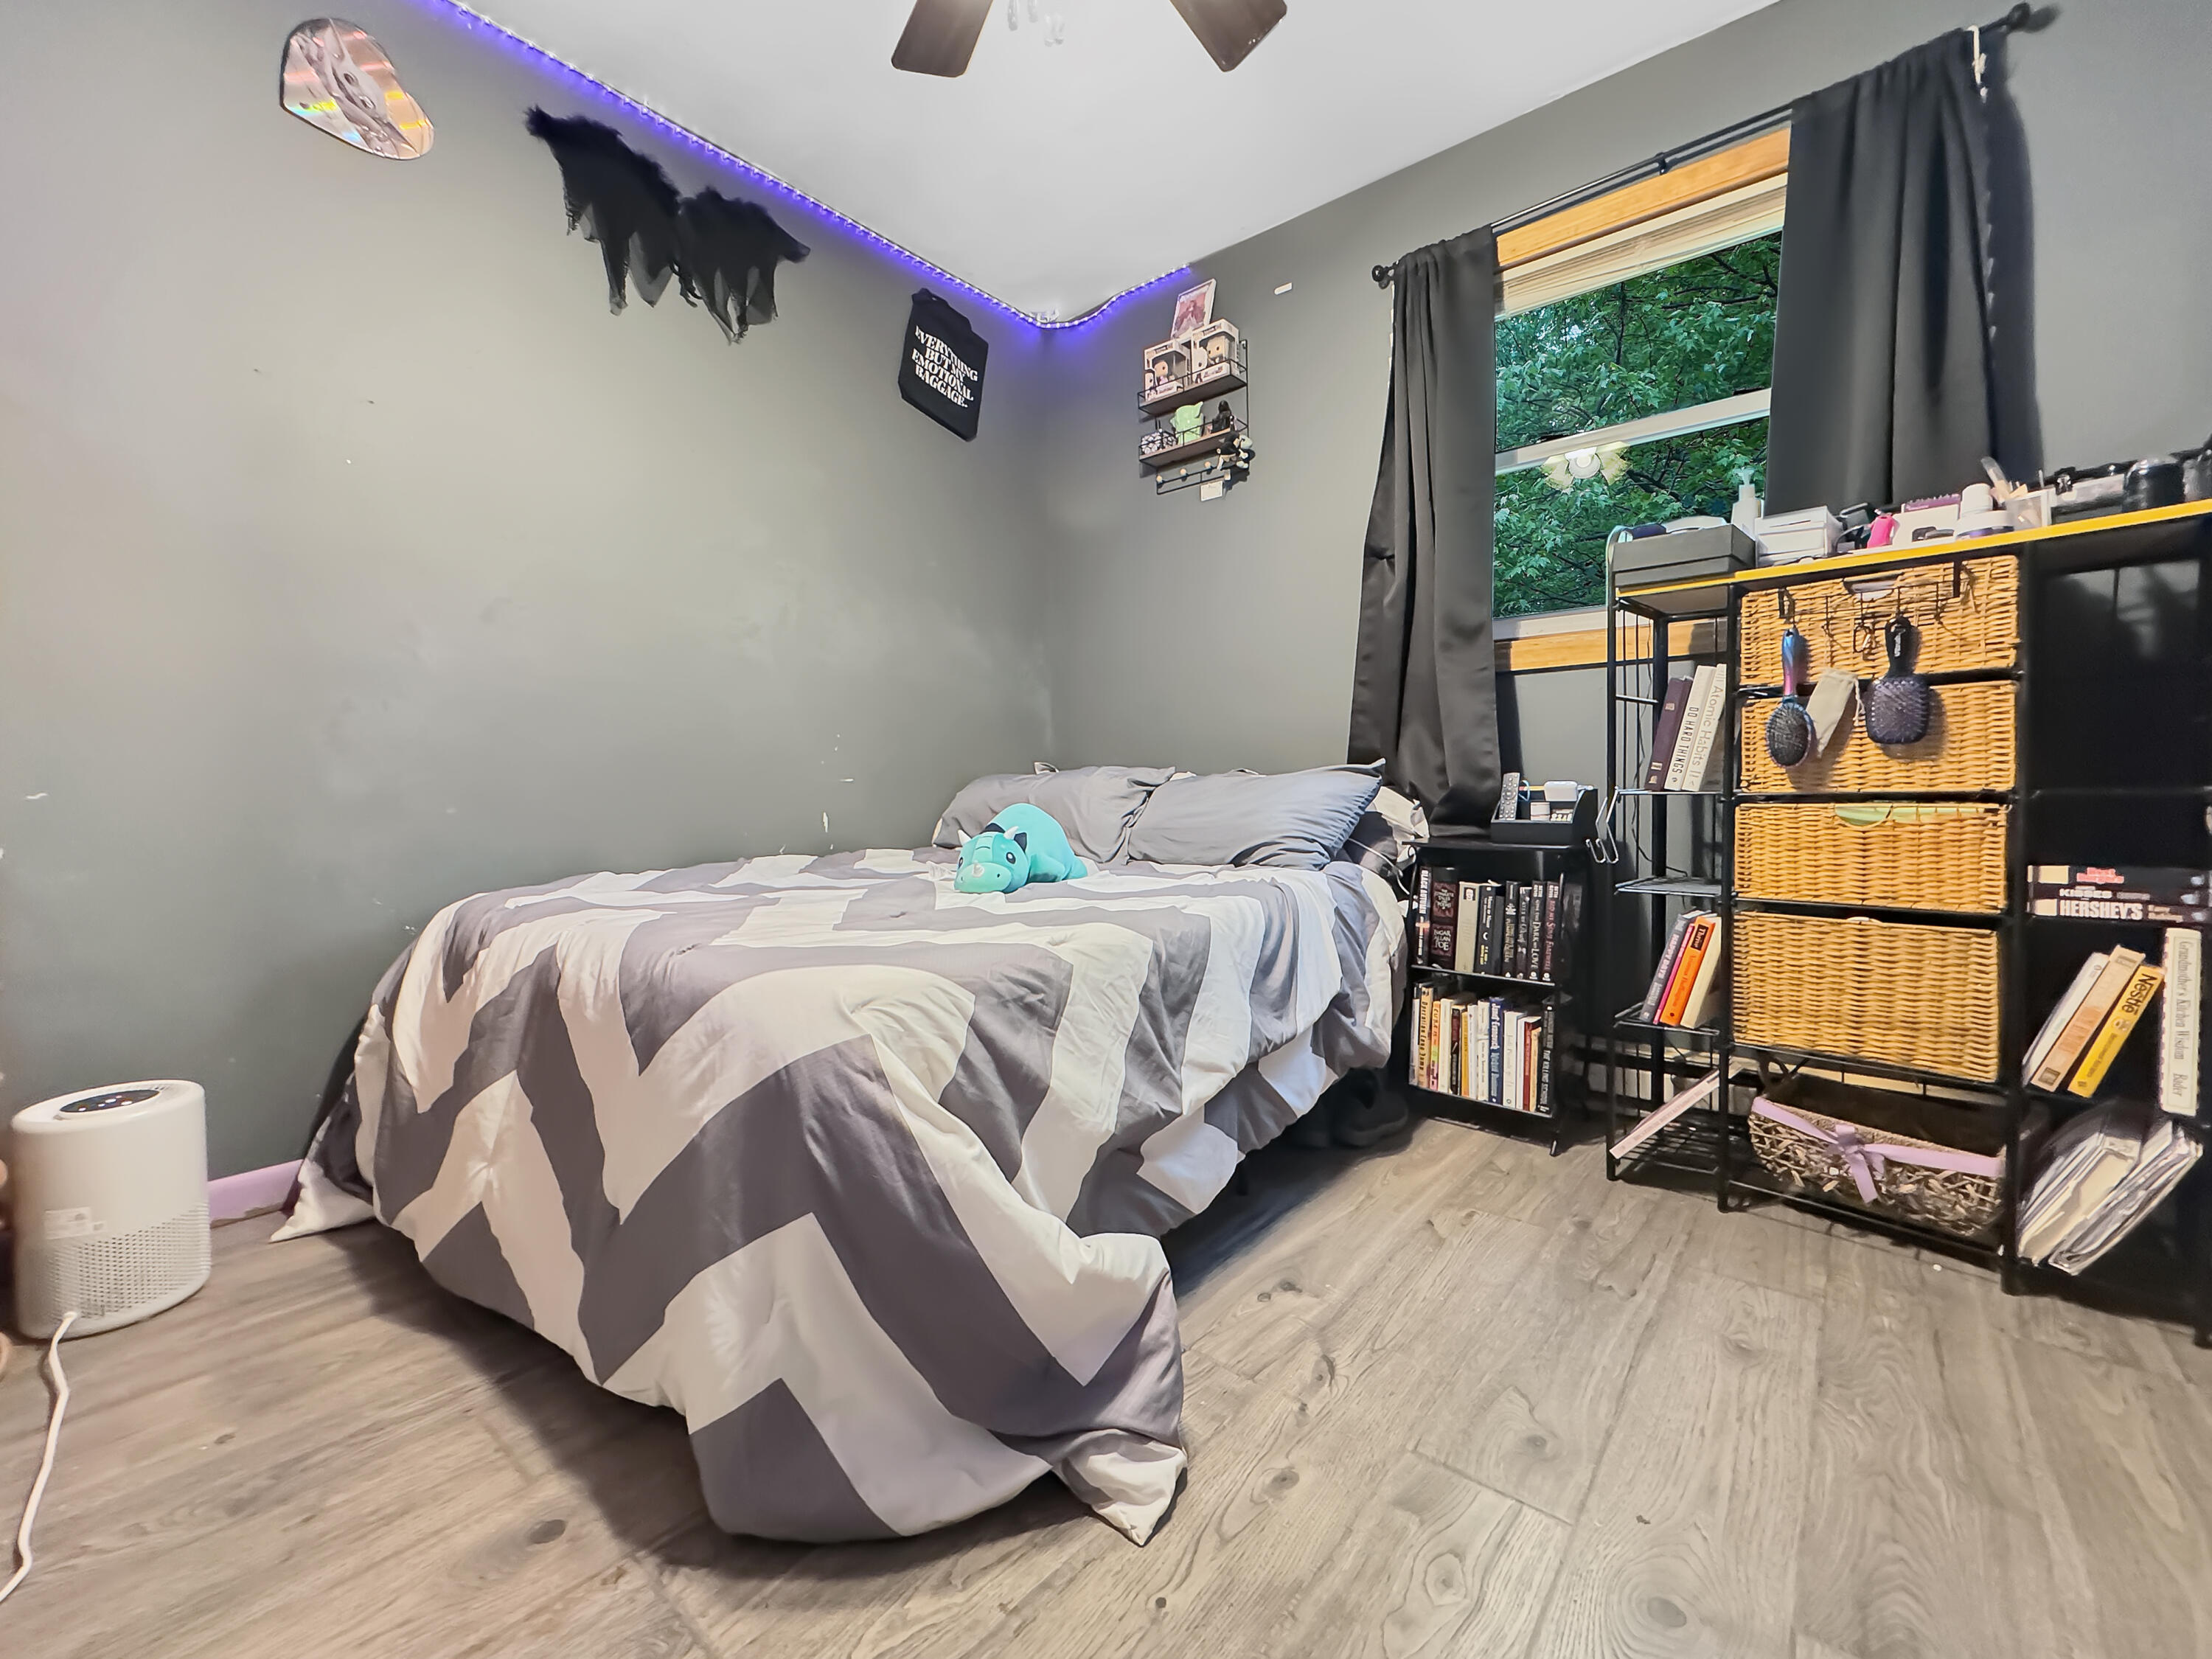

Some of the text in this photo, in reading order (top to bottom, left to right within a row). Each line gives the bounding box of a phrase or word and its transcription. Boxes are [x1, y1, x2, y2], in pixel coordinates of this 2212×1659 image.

[915, 324, 978, 381] EVERYTHING
[925, 347, 965, 383] BUT MY
[911, 348, 974, 401] EMOTIONAL
[1672, 706, 1699, 773] DO HARD THINGS
[1692, 685, 1723, 766] Atomic Habits
[1420, 870, 1429, 889] BLACK
[1419, 889, 1428, 914] AUTUMN
[2059, 900, 2143, 920] HERSHEY'S
[1533, 922, 1542, 942] DARK
[1531, 948, 1540, 969] LOVE
[2177, 941, 2194, 996] Grandmother's
[2176, 998, 2191, 1028] Kitchen
[2174, 1030, 2190, 1060] Wisdom
